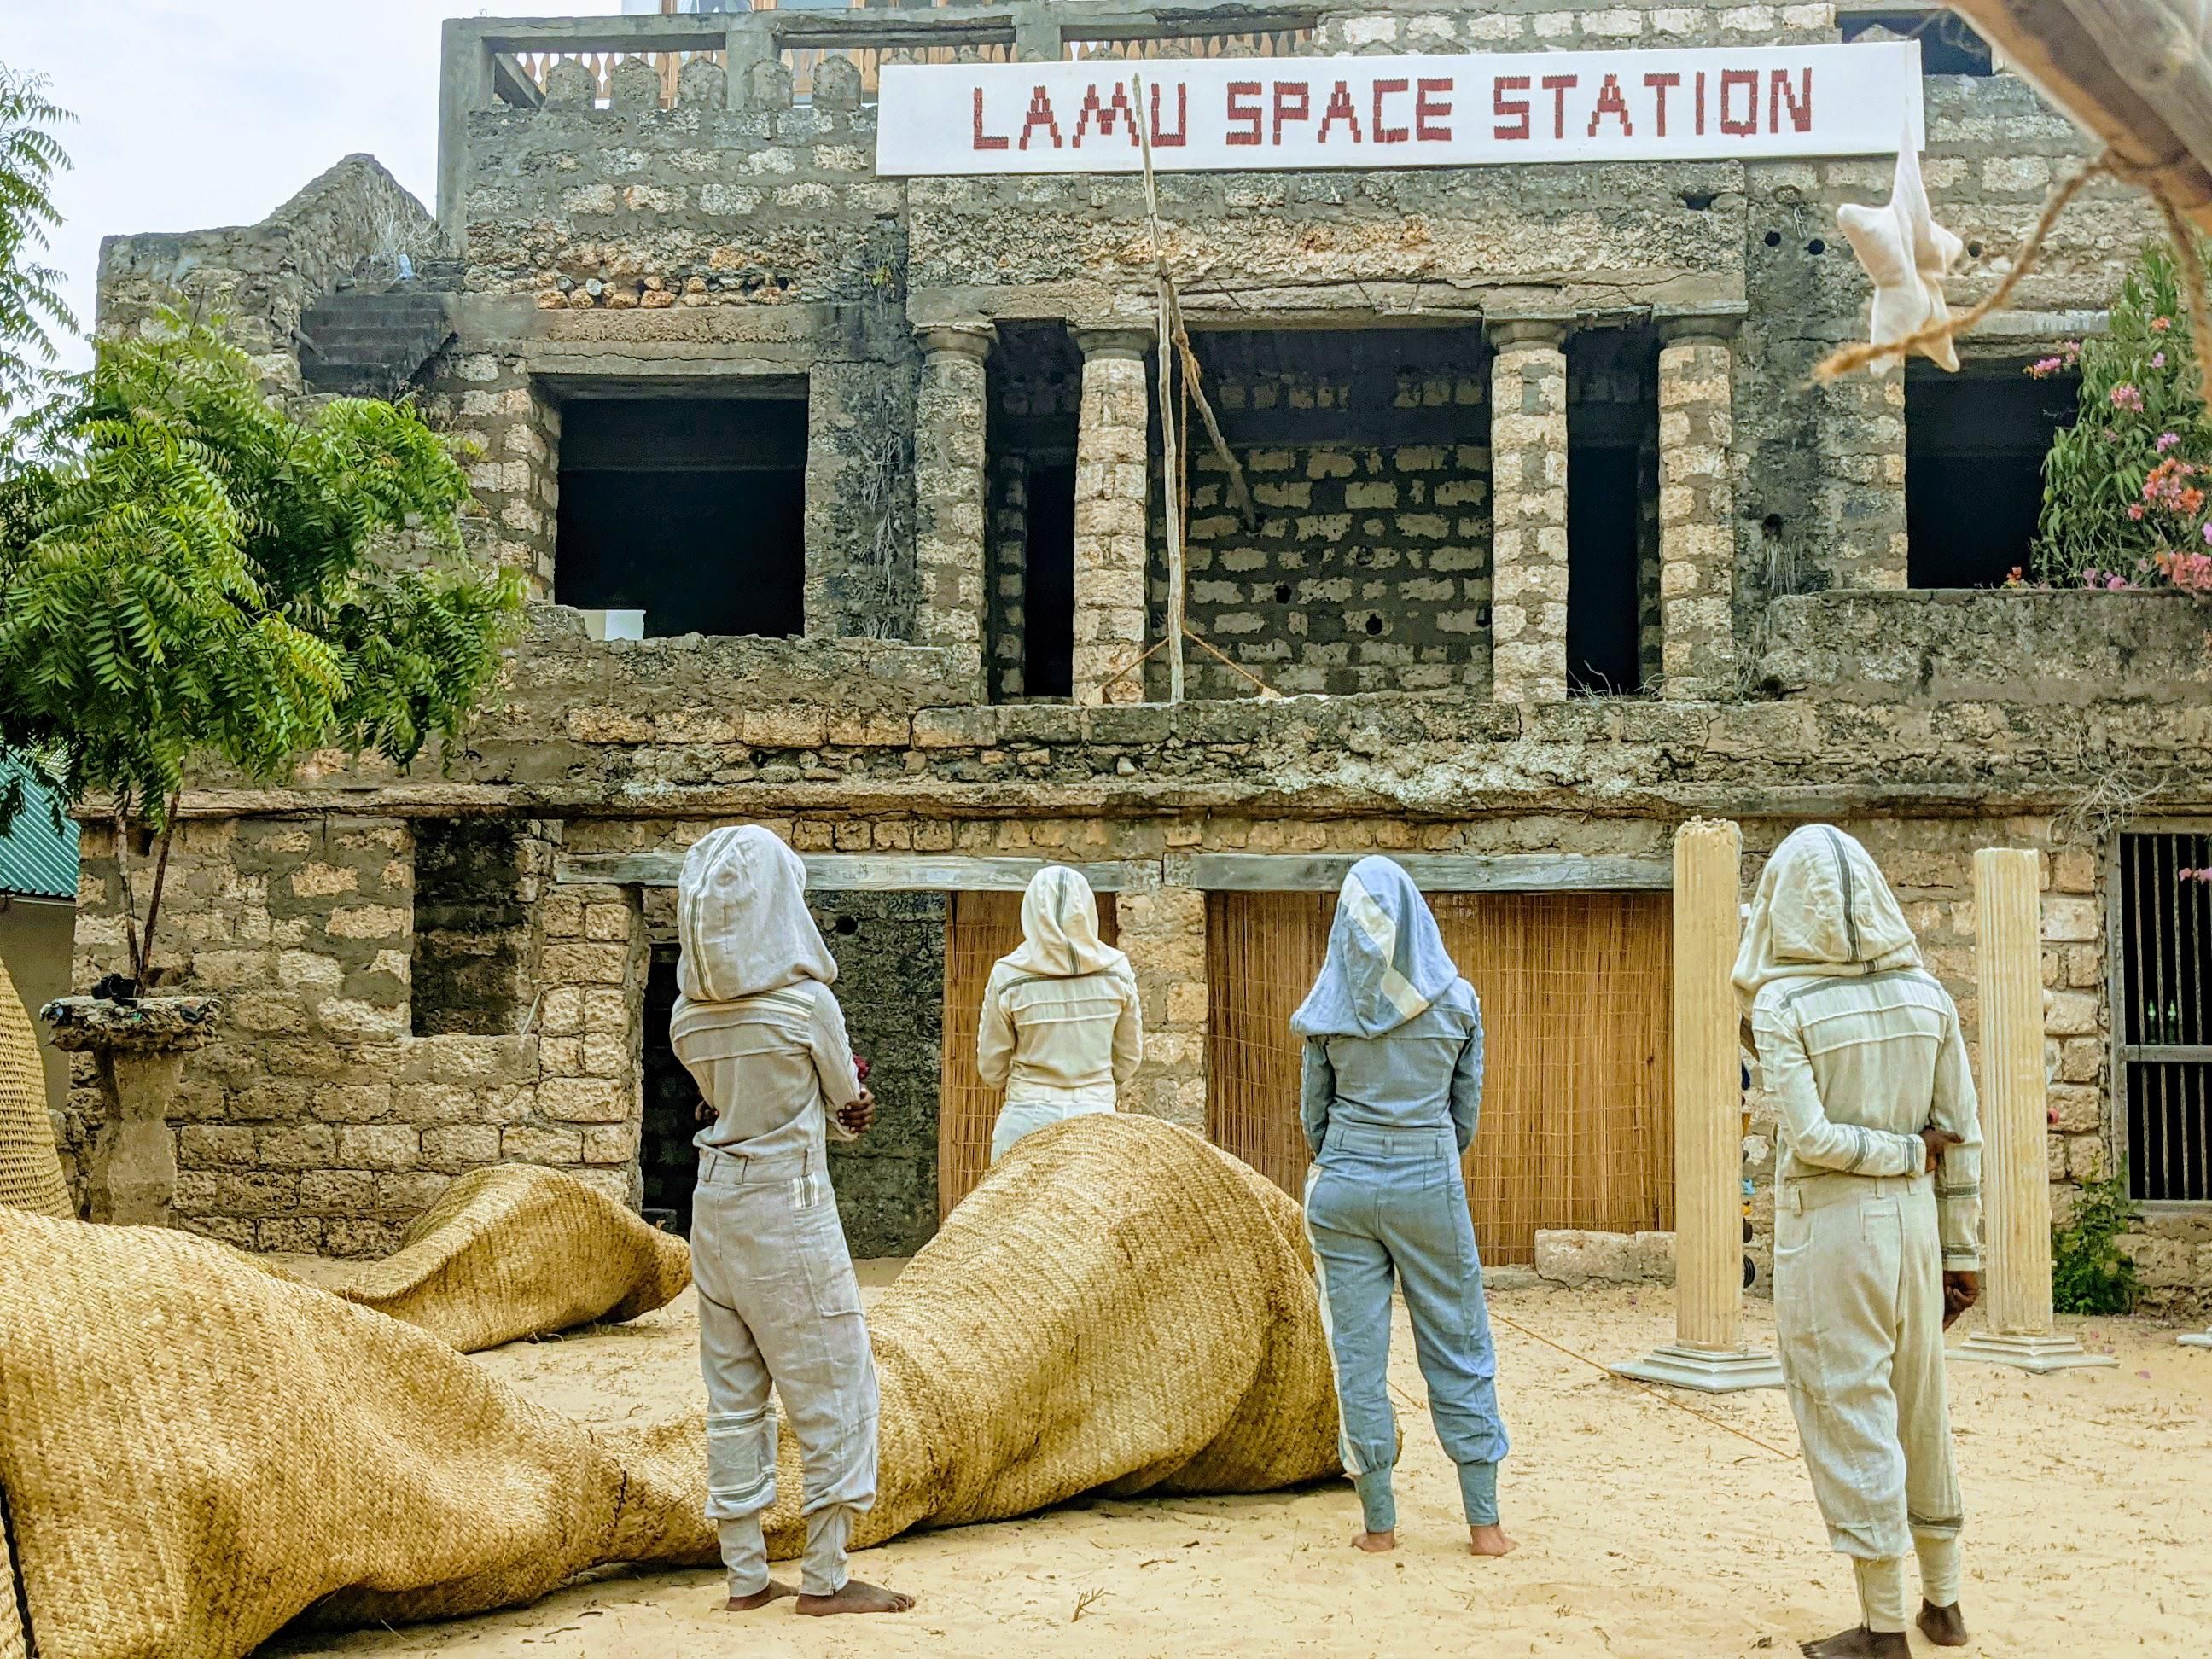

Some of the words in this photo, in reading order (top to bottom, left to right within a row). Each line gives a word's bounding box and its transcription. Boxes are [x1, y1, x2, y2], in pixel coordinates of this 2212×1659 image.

[973, 82, 1187, 150] LAMU
[1226, 77, 1452, 147] SPACE
[1493, 67, 1812, 141] STATION
